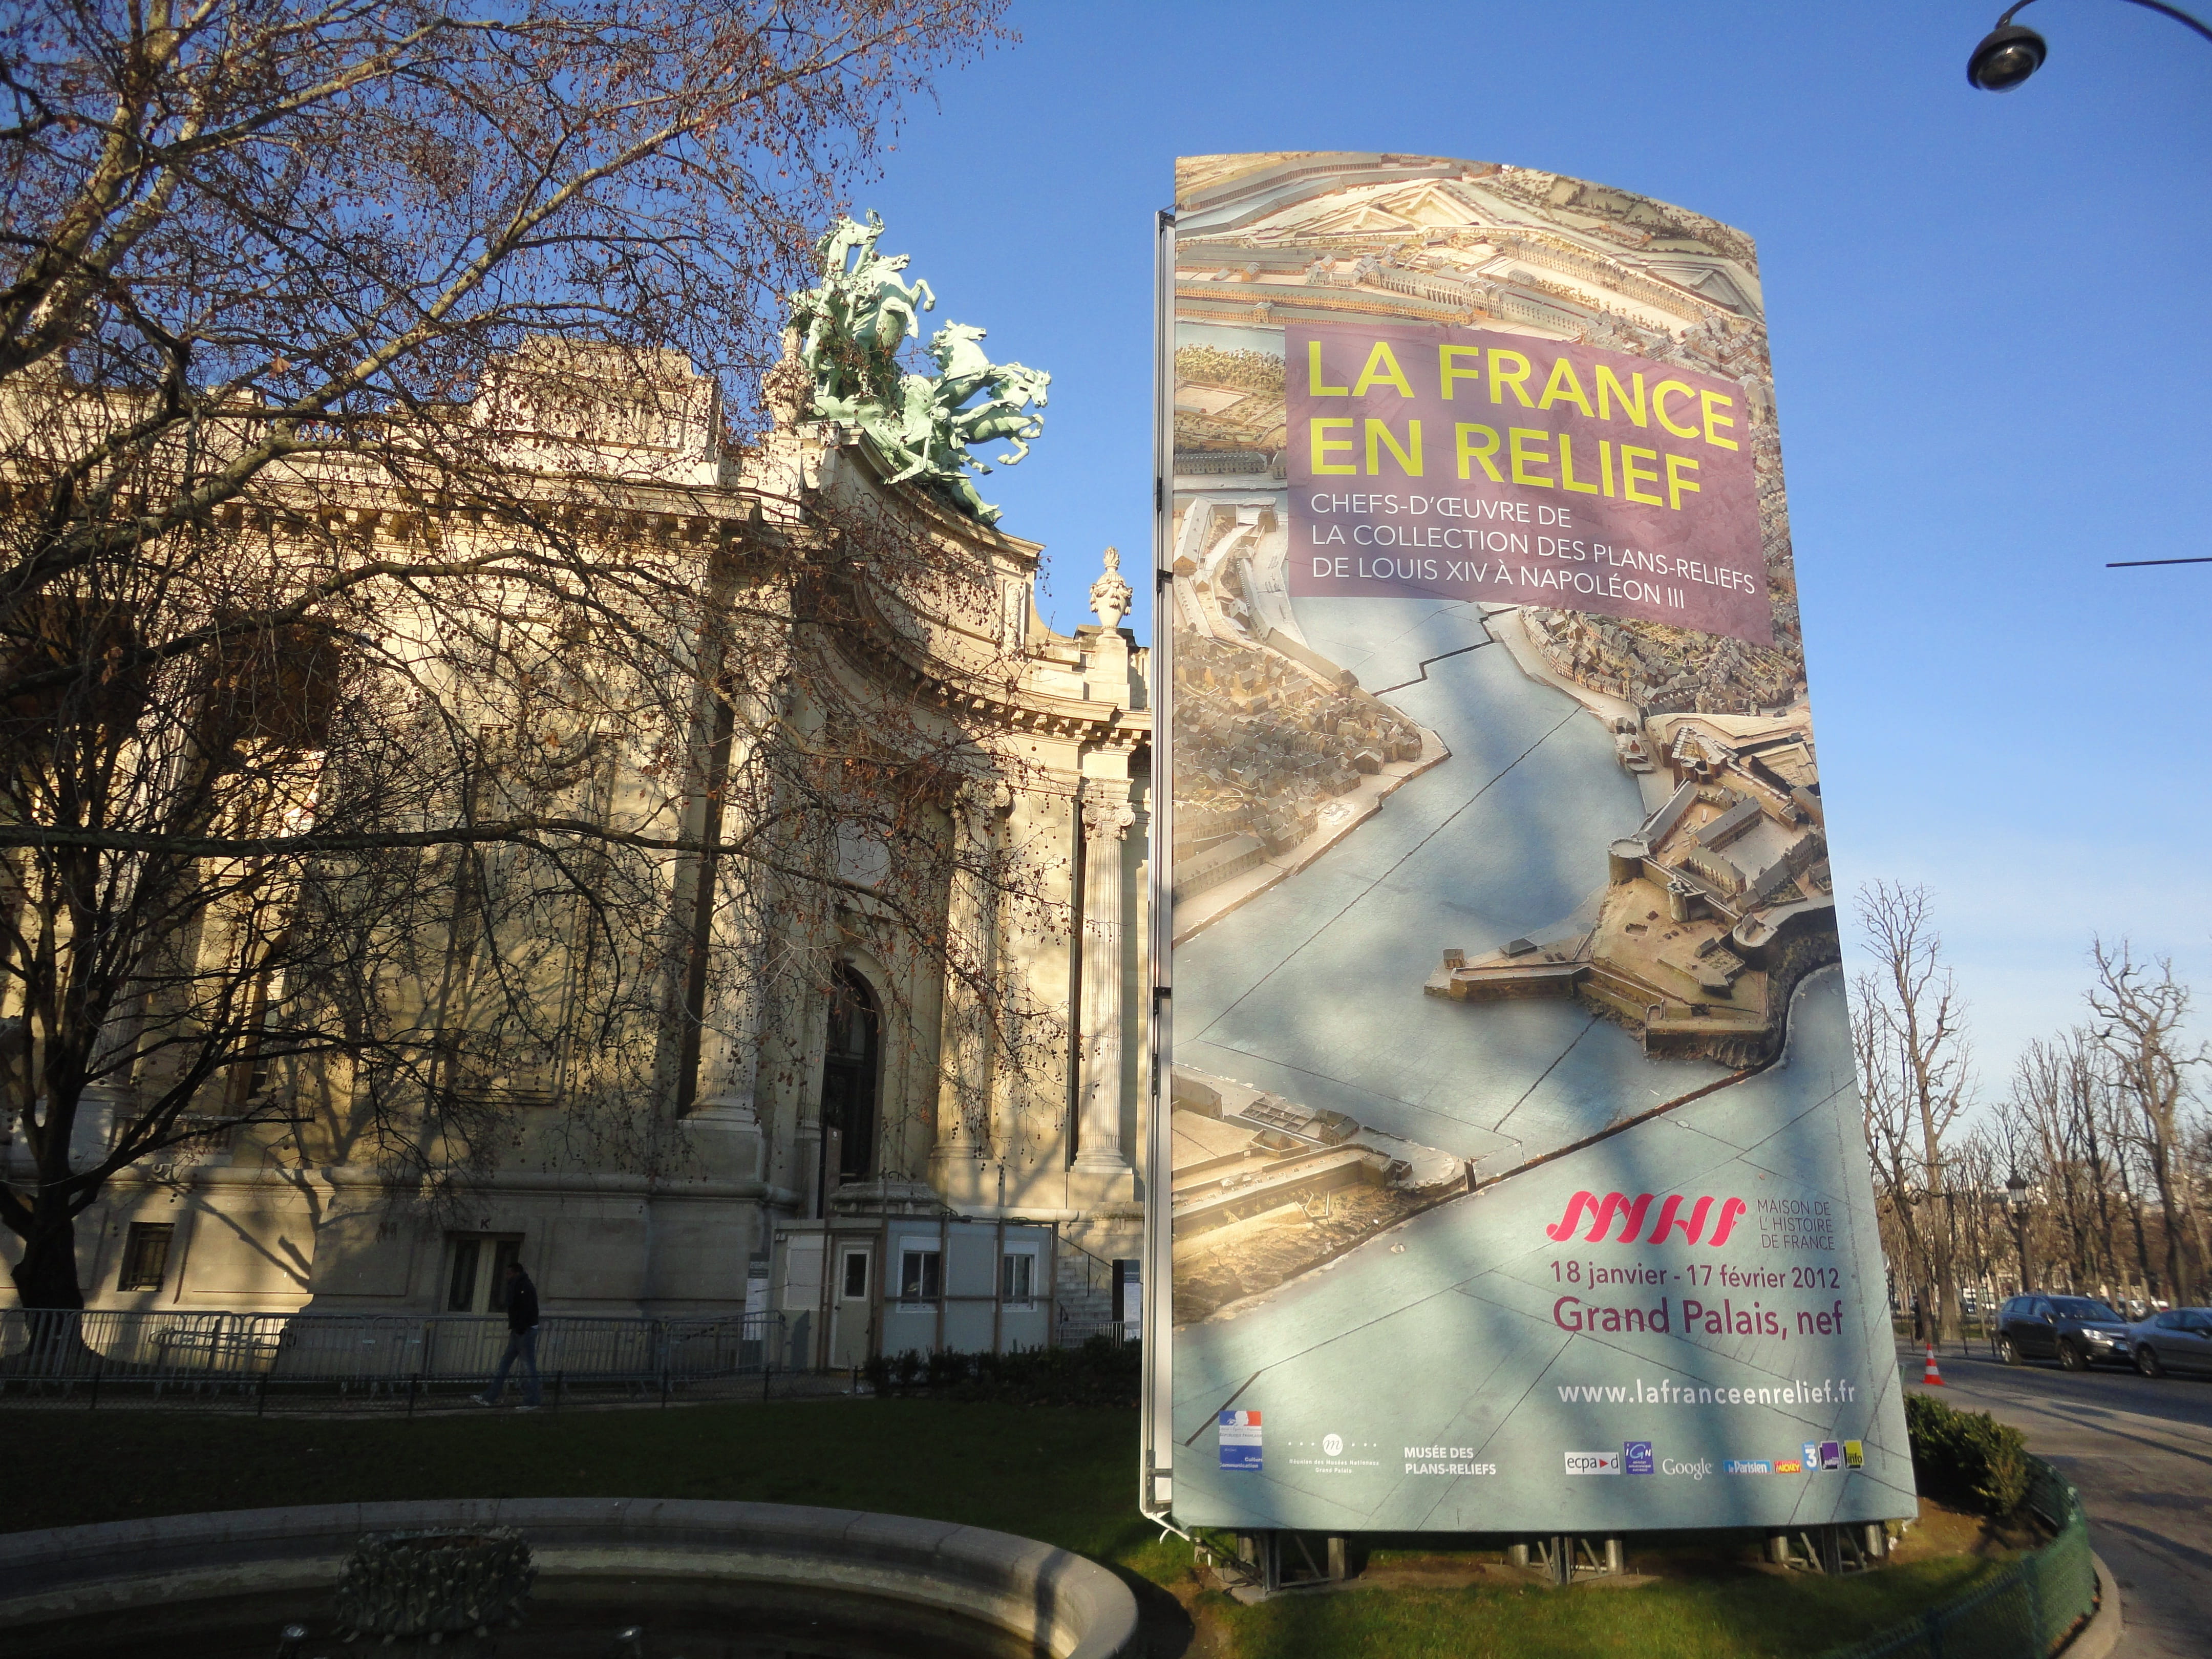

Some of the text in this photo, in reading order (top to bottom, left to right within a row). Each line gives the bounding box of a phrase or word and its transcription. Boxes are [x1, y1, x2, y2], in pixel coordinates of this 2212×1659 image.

[1309, 341, 1738, 453] LA FRANCE
[1310, 418, 1700, 510] EN RELIEF
[1538, 505, 1572, 528] DE
[1312, 523, 1755, 595] LA COLLECTION DES PLANS-RELIEFS
[1313, 557, 1684, 609] DE LOUIS XIV À NAPOLÉON III
[1757, 1199, 1831, 1216] MAISON DE
[1761, 1234, 1835, 1250] DE FRANCE
[1550, 1260, 1582, 1283] 18
[1588, 1261, 1667, 1290] janvier
[1687, 1264, 1713, 1286] 17
[1719, 1264, 1785, 1288] février
[1791, 1267, 1840, 1288] 2012
[1552, 1295, 1669, 1333] Grand
[1683, 1298, 1788, 1341] Palais,
[1796, 1300, 1843, 1335] nef
[1558, 1378, 1855, 1405] www.lafranceenrelief.fr
[1404, 1444, 1473, 1458] MUSÉE DES
[1805, 1448, 1817, 1468] 3
[1405, 1463, 1496, 1475] PLANS-RELIEFS
[1662, 1458, 1712, 1480] Google
